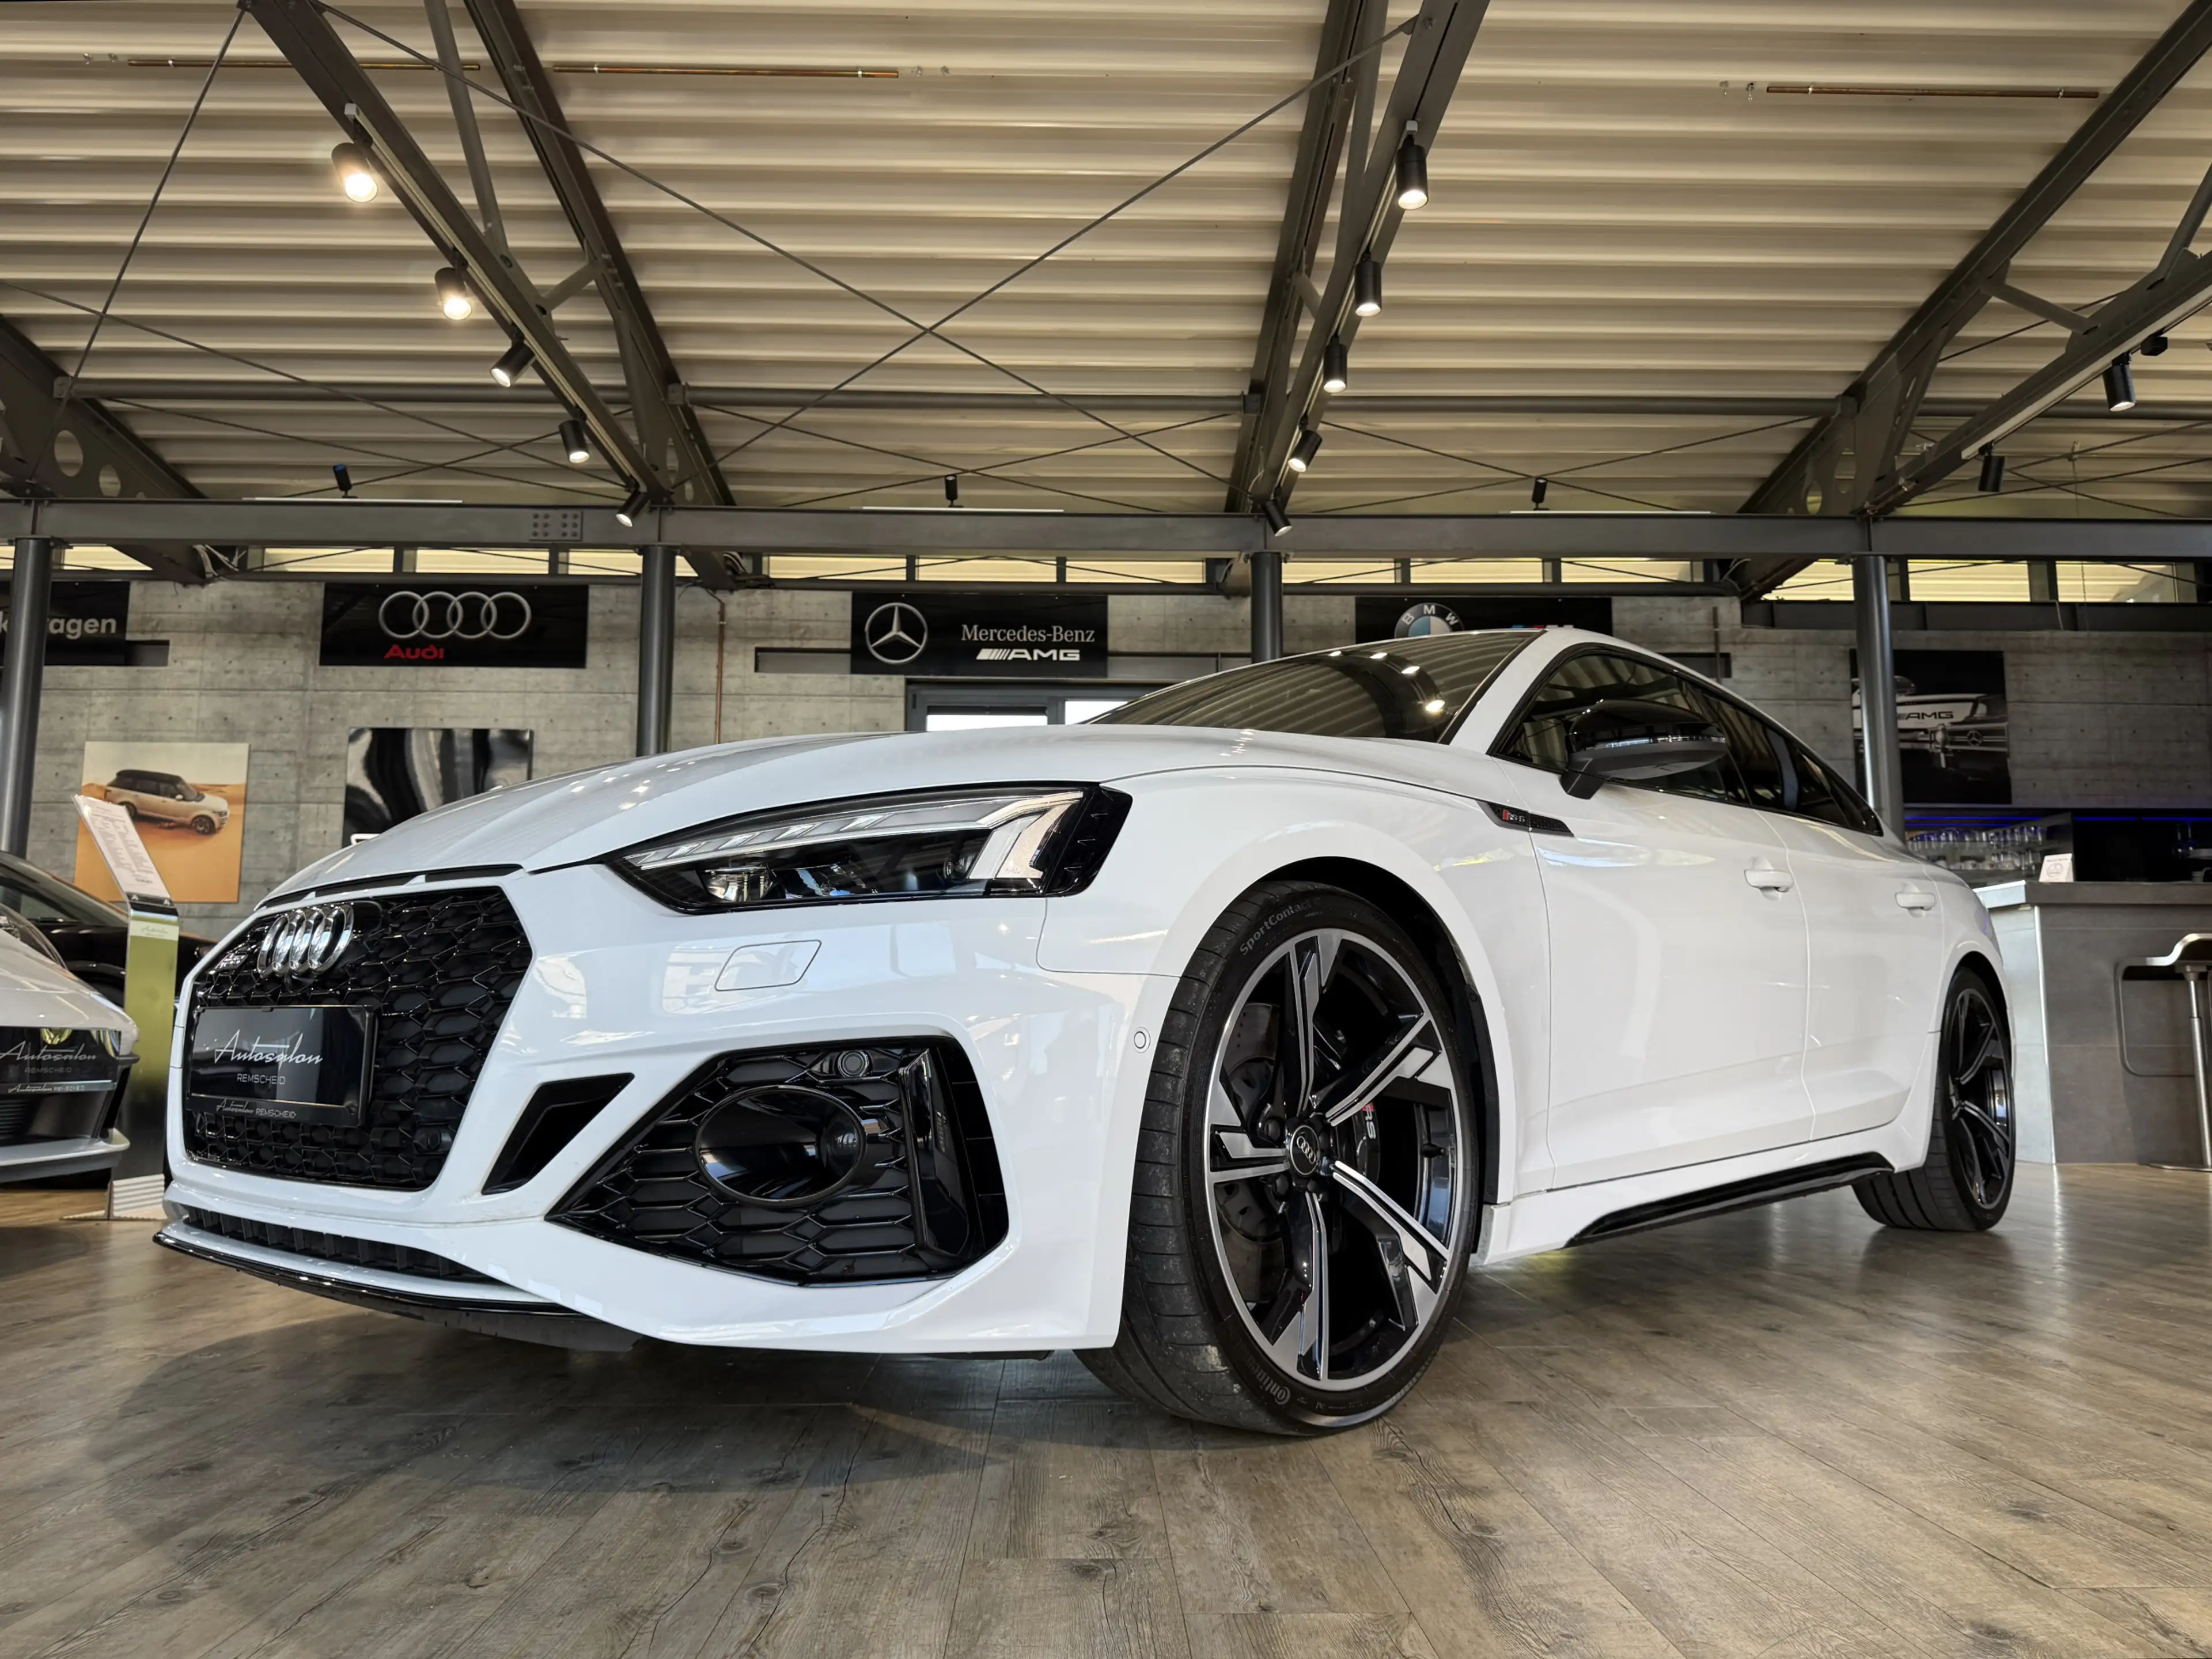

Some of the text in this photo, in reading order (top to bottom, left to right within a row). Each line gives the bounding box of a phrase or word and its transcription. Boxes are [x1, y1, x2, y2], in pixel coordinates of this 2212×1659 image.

[1402, 604, 1459, 625] BMW
[961, 624, 1095, 642] Mercedes-Benz
[384, 644, 444, 659] Audi
[1007, 649, 1080, 661] AMG
[1906, 711, 1953, 720] AMG
[1240, 898, 1312, 956] SportContact
[0, 1040, 97, 1062] Autosalon
[215, 1029, 323, 1064] Autosalon
[237, 1073, 286, 1085] REMSCHEID
[216, 1098, 297, 1119] Autosalon REMSCHEID
[1233, 1338, 1291, 1405] Continen
